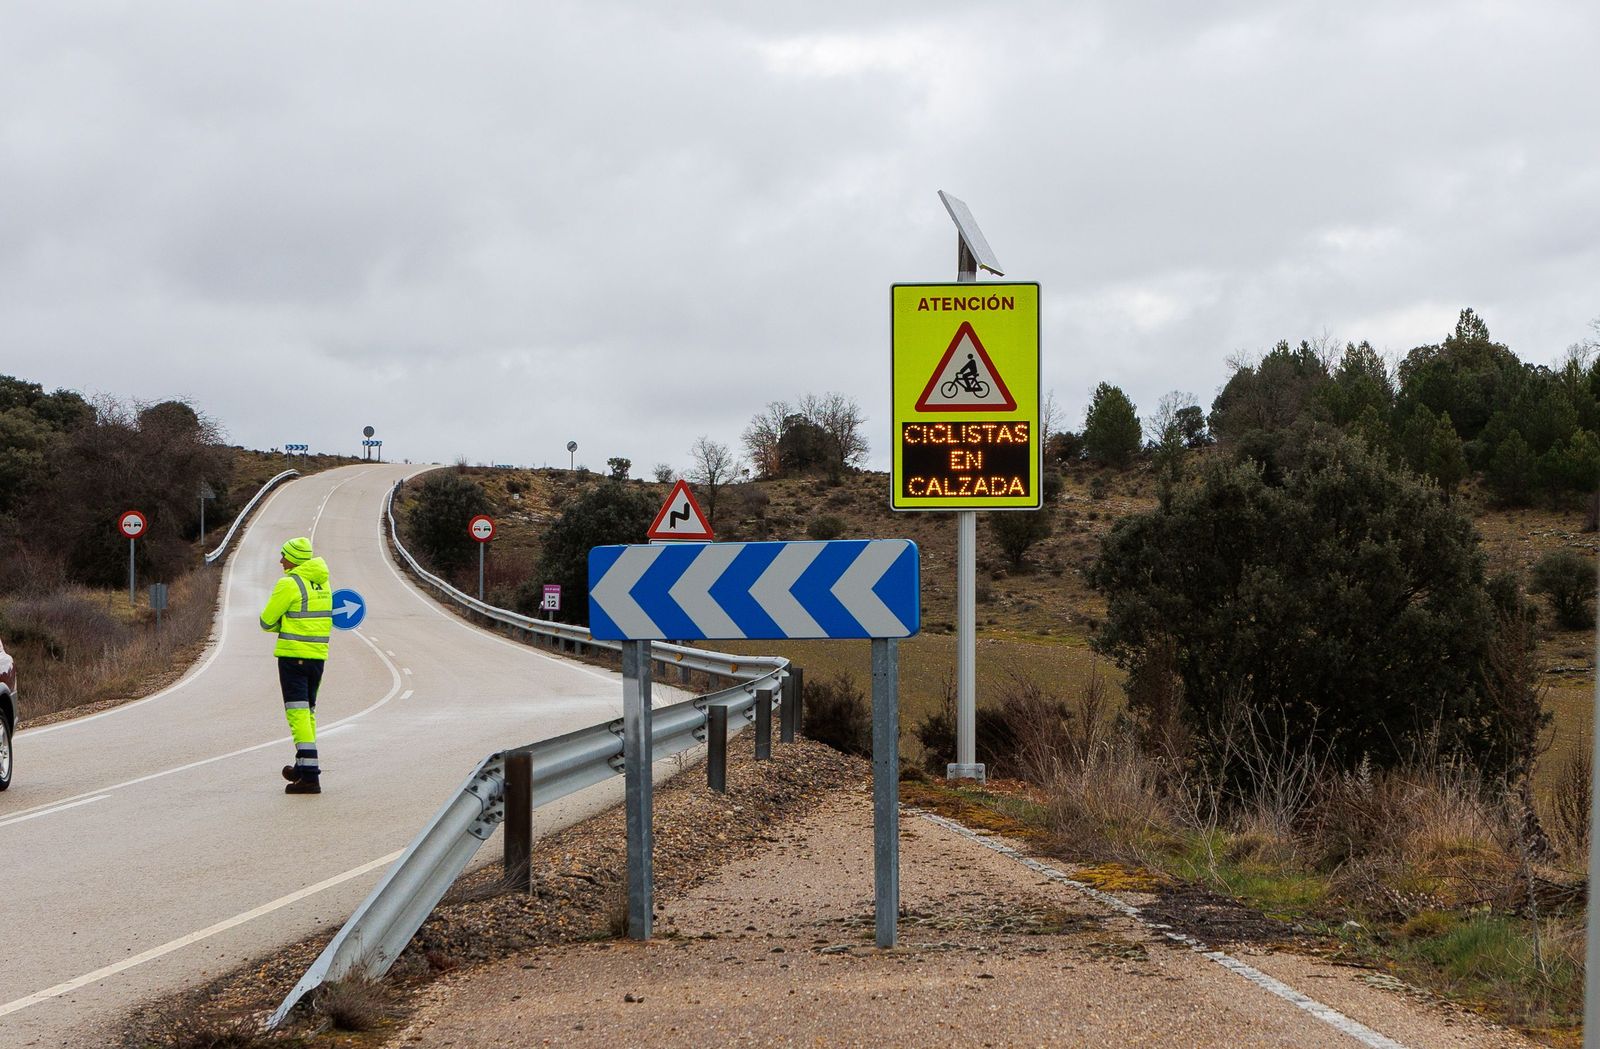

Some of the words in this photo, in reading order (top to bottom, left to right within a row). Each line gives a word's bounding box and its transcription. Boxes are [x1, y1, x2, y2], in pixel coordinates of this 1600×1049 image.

[918, 294, 1014, 311] ATENCIÓN
[905, 425, 1028, 443] CICLISTAS
[951, 451, 982, 469] EN
[908, 477, 1025, 495] CALZADA
